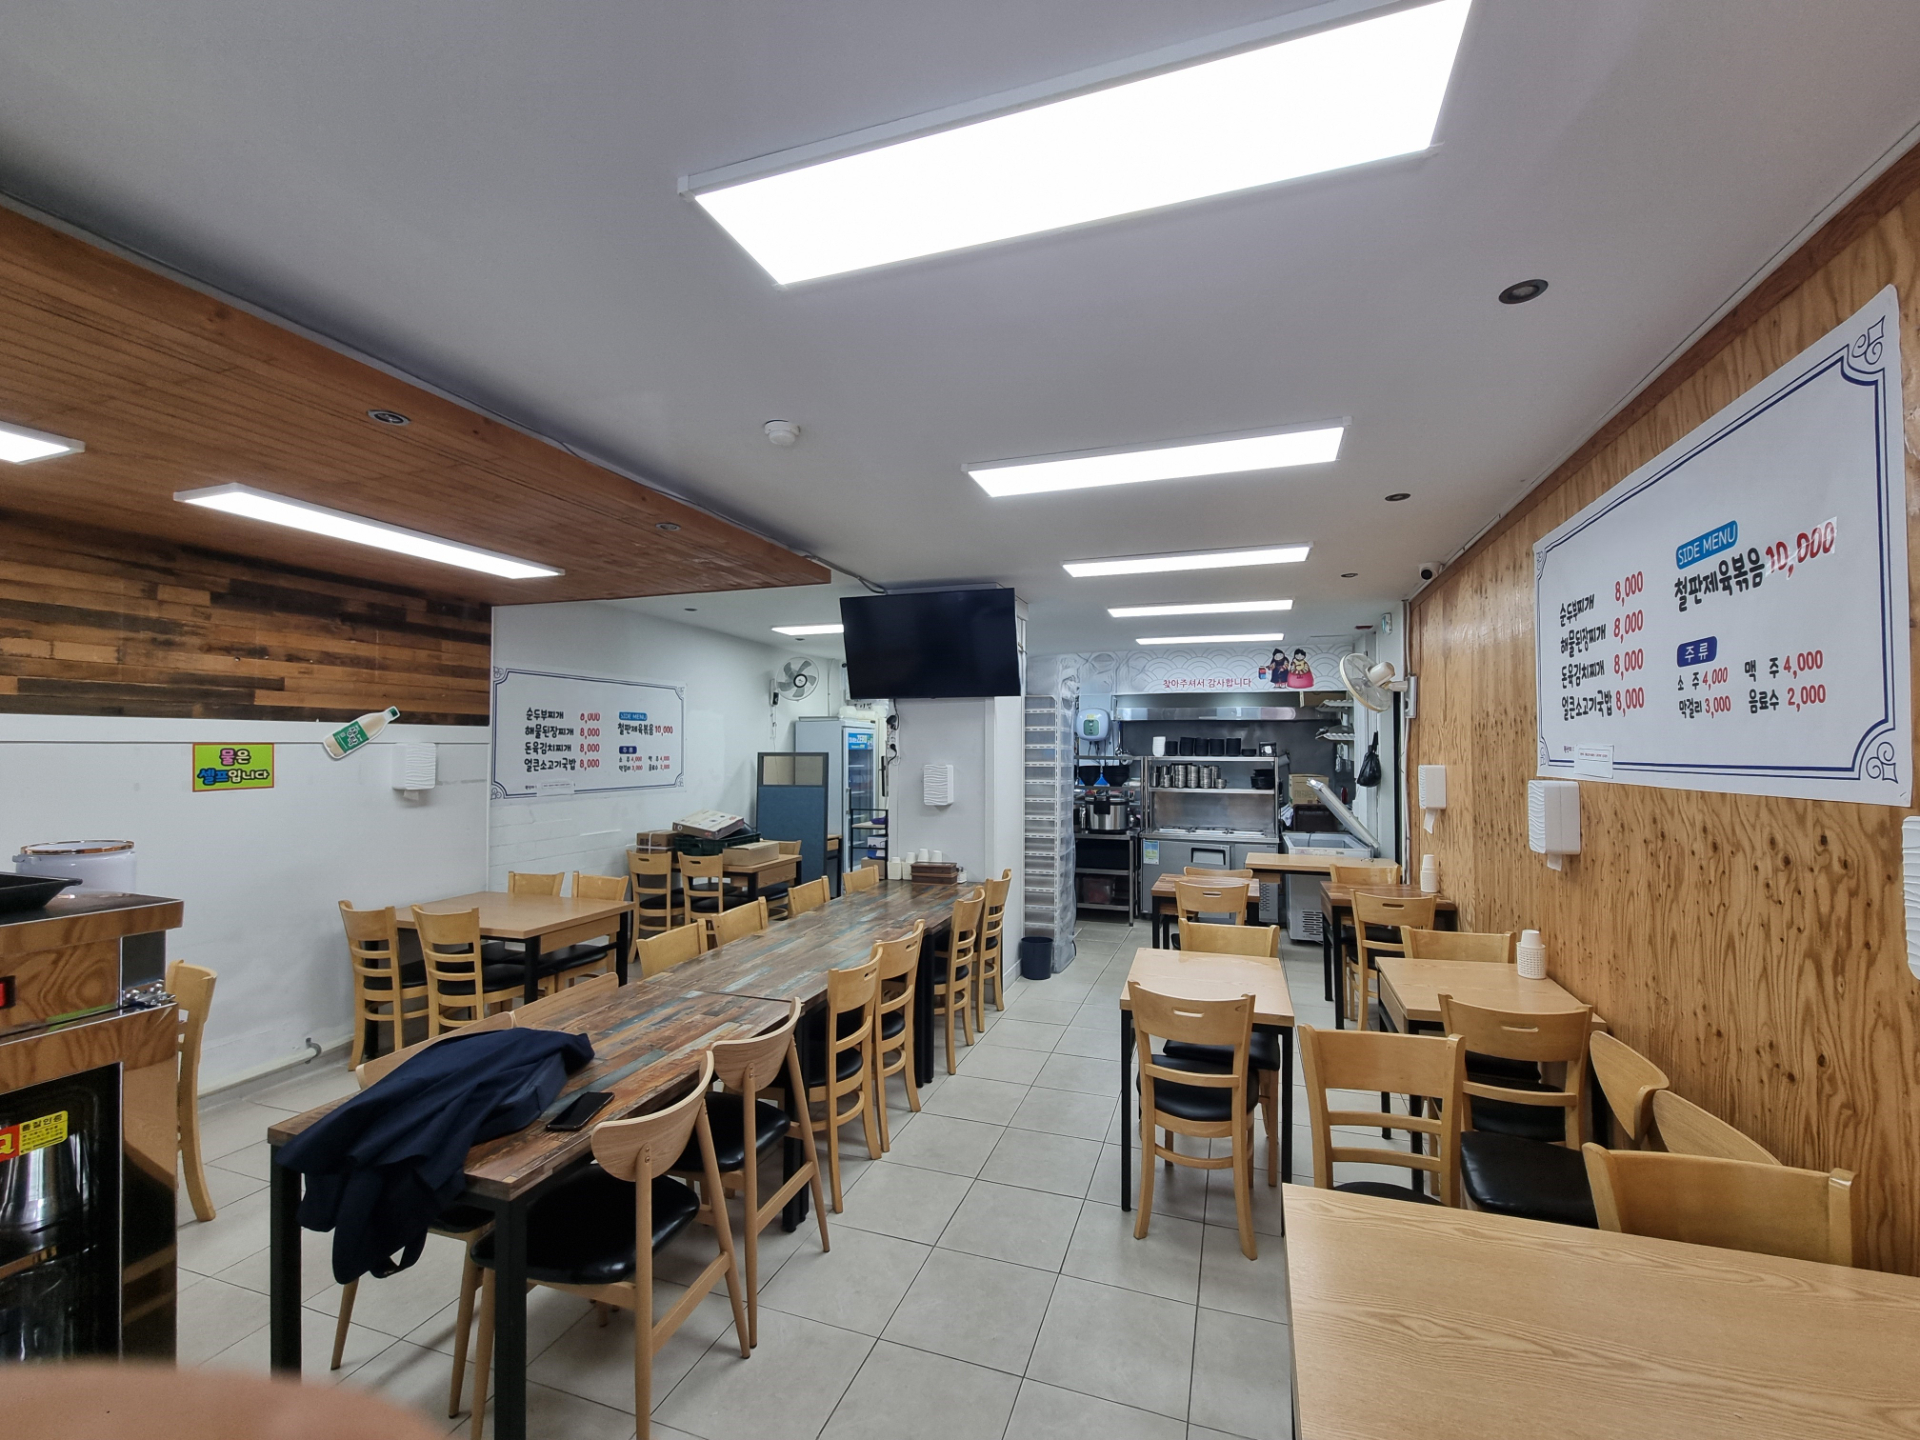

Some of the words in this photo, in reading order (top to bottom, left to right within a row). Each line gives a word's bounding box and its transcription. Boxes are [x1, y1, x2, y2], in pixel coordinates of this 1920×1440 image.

[1677, 541, 1700, 565] SIDE
[1702, 524, 1736, 551] MENU
[1674, 547, 1764, 612] 철판제육볶음
[1765, 522, 1835, 578] 10,000
[1559, 594, 1595, 627] 순두부찌개
[1615, 571, 1644, 607] 8,000
[1561, 624, 1606, 658] 해물된장찌개
[1613, 609, 1644, 644] 8,000
[1561, 659, 1605, 689] 돈육김치찌개
[1614, 648, 1644, 681] 8,000
[1783, 650, 1823, 679] 4,000
[1162, 678, 1205, 688] 찾아주셔서
[1207, 678, 1252, 688] 감사합니다
[1702, 667, 1728, 690] 4,000
[1562, 690, 1612, 721] 얼큰소고기국밥
[1615, 687, 1645, 717] 8,000
[1679, 698, 1702, 719] 막걸리
[1704, 695, 1731, 718] 3,000
[1748, 689, 1779, 714] 음료수
[1787, 684, 1826, 712] 2,000
[526, 707, 564, 721] 순두부찌개
[525, 724, 574, 739] 해물된장찌개
[580, 727, 600, 740] 8,000
[655, 725, 673, 736] 10,000
[219, 748, 252, 766] 물은
[525, 741, 572, 755] 돈육김치찌개
[580, 743, 600, 755] 8,000
[524, 757, 576, 772] 얼큰소고기국밥
[579, 758, 600, 771] 8,000
[197, 767, 270, 786] 셀프입니다
